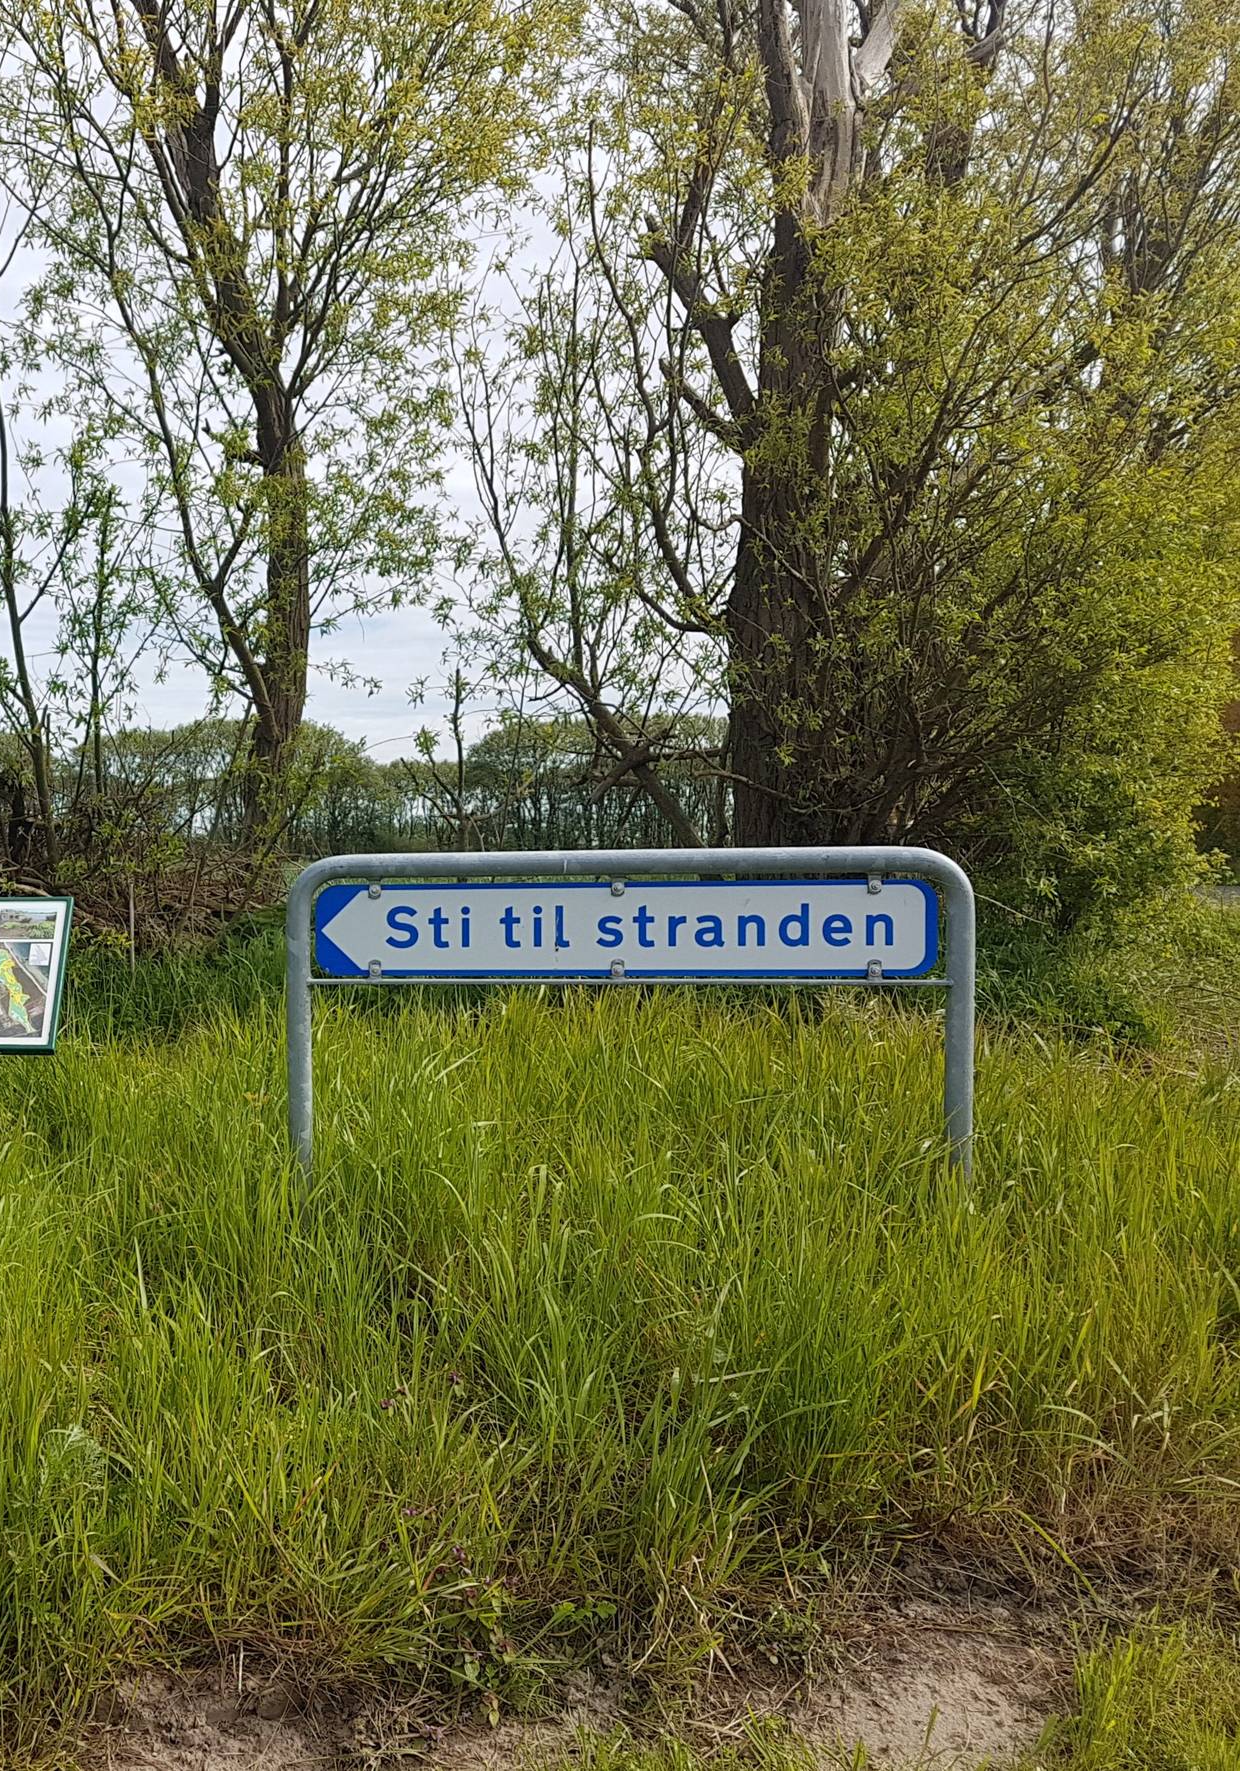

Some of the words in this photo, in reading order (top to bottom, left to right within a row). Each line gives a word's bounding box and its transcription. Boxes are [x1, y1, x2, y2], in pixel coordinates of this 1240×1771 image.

[385, 905, 471, 949] Sti
[500, 904, 570, 949] til
[596, 902, 895, 948] stranden
